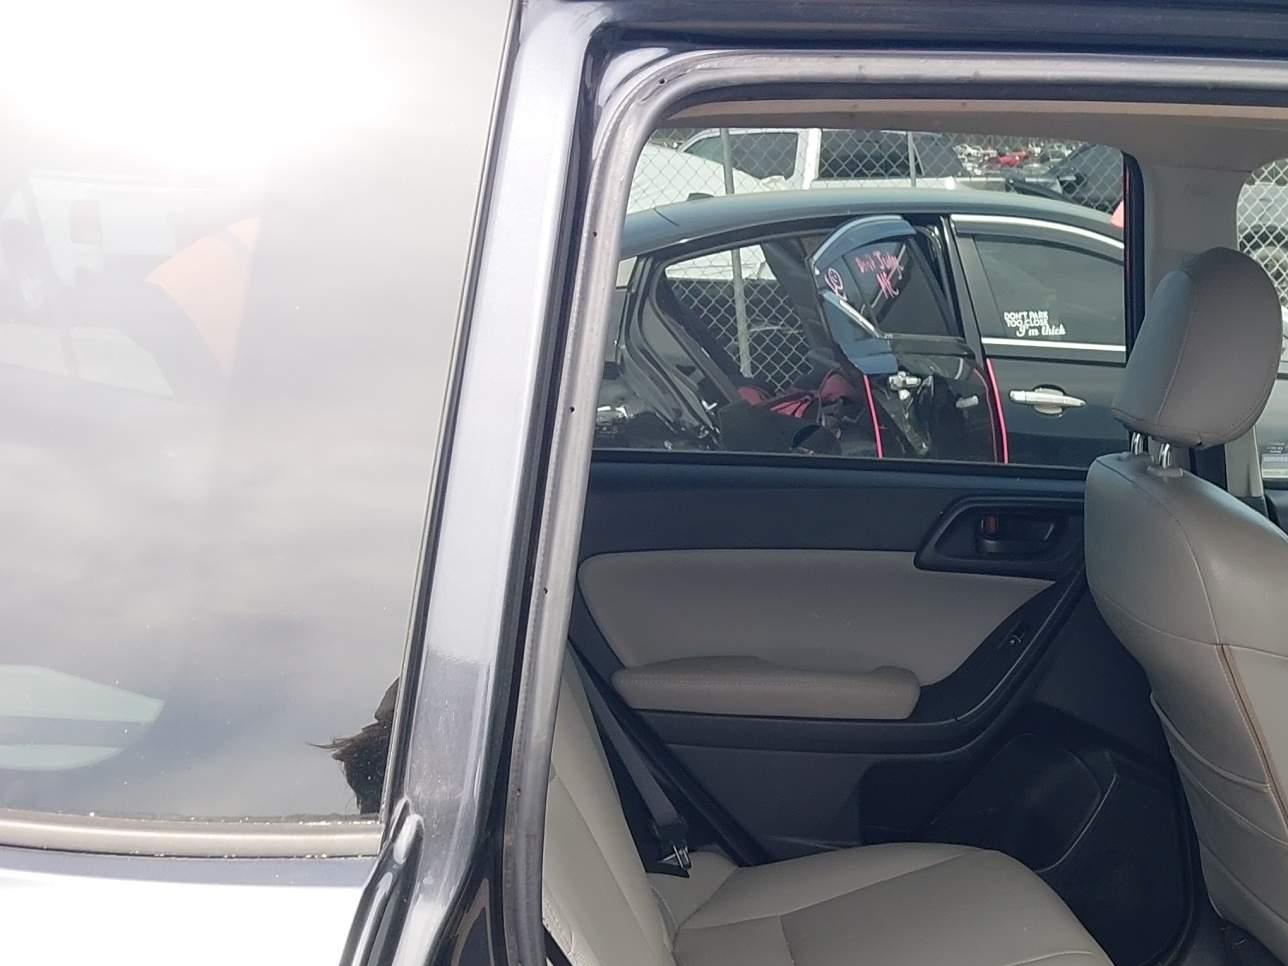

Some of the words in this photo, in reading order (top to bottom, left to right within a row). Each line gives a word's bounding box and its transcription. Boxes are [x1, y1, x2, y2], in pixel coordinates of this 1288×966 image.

[1029, 310, 1049, 321] PARK
[1007, 319, 1023, 328] TOO
[1024, 319, 1049, 327] CLOSE
